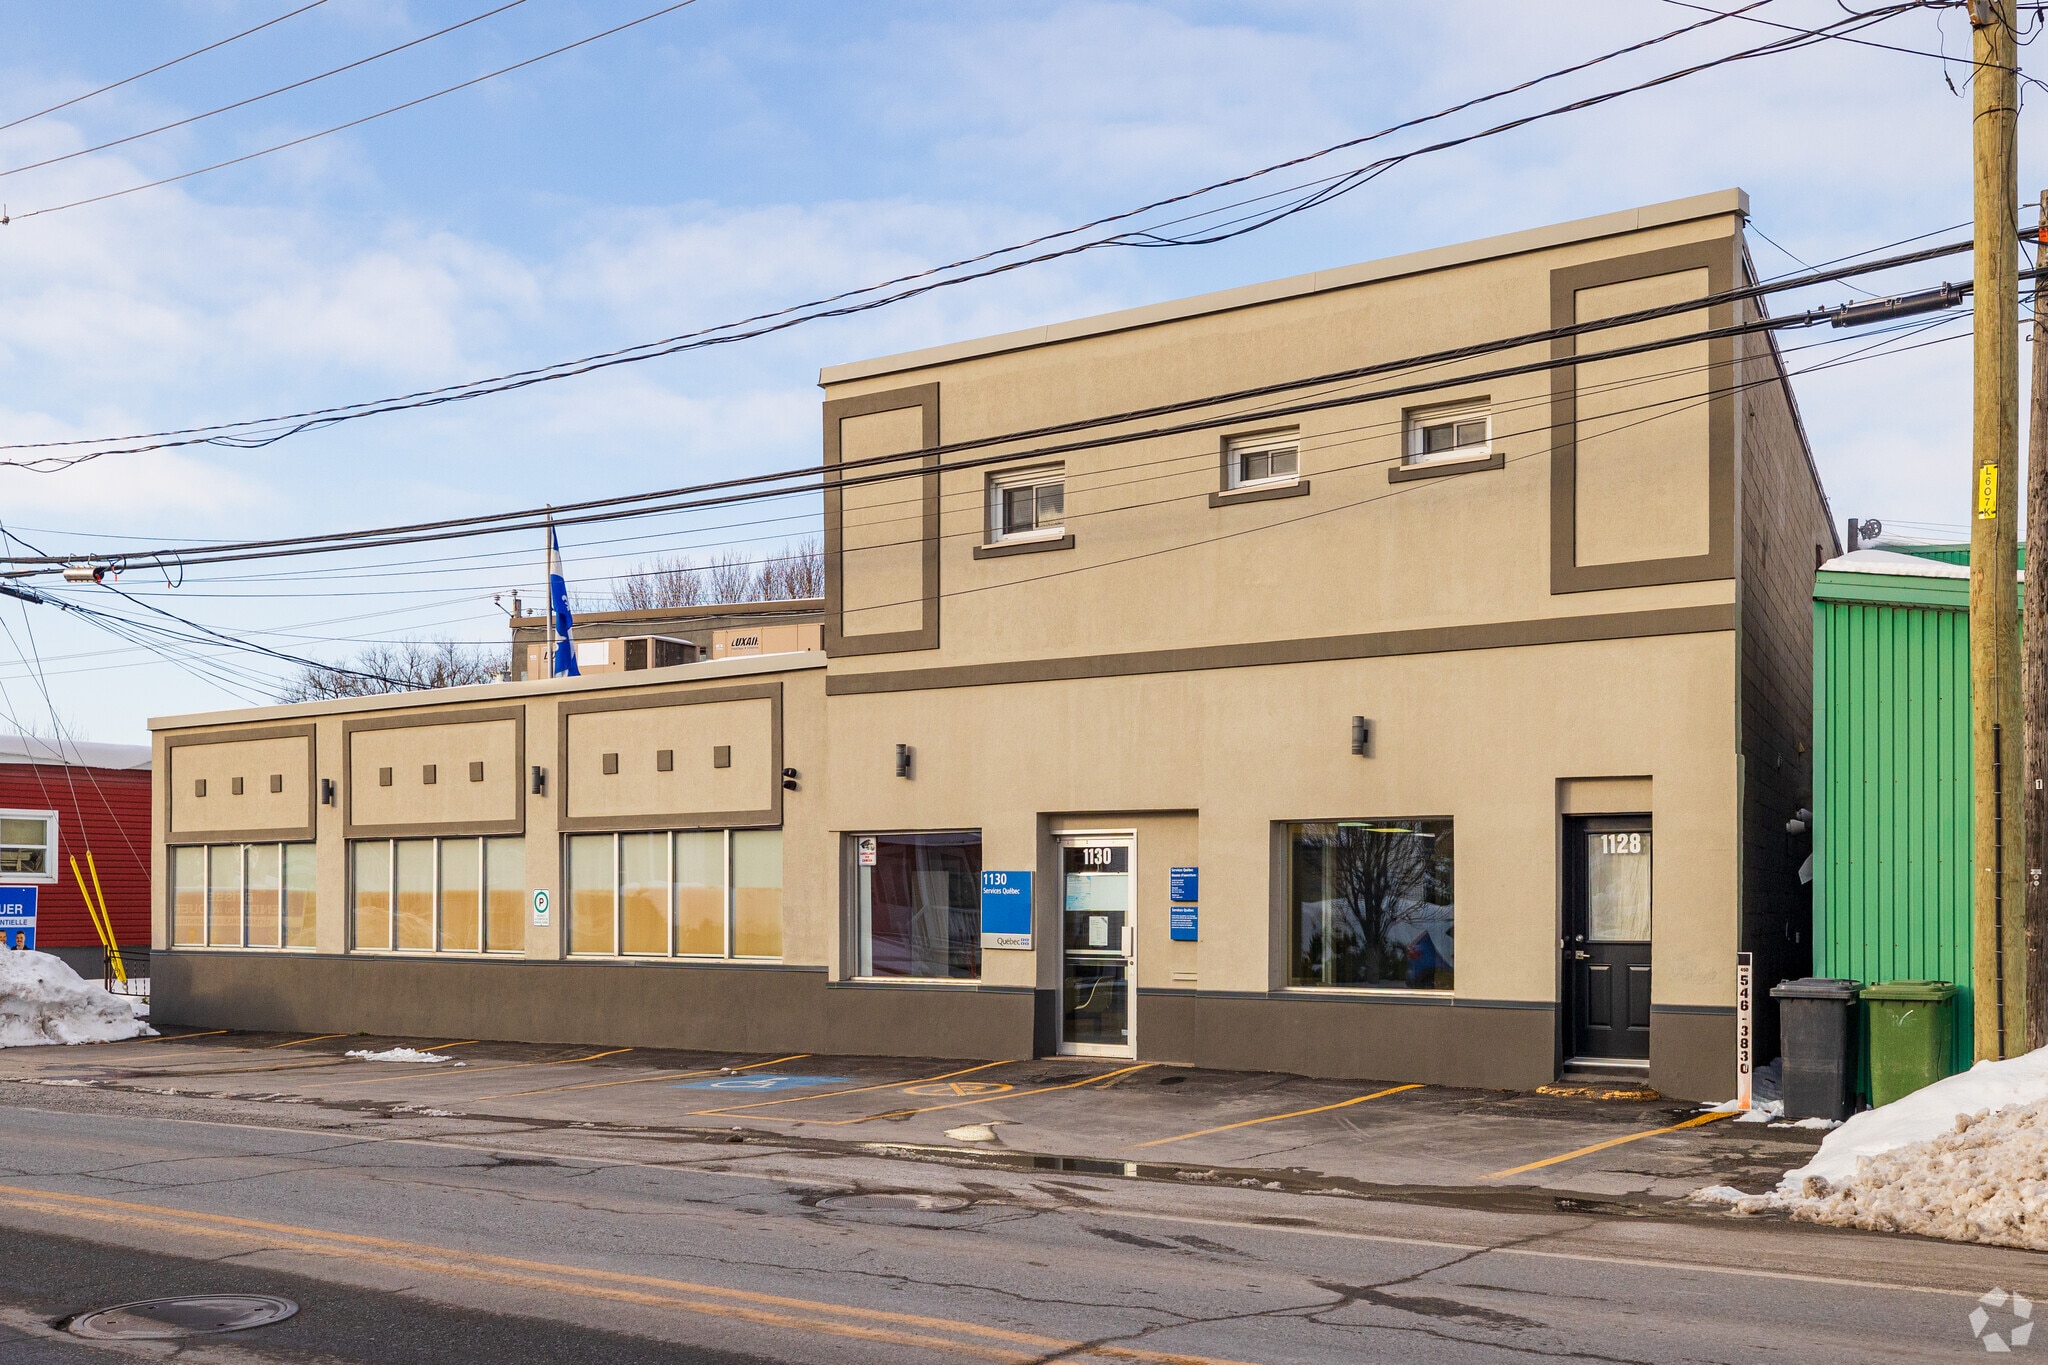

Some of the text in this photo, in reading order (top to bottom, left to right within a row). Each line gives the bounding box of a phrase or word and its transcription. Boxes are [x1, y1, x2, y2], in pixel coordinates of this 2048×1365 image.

[1600, 833, 1641, 854] 1128
[1083, 847, 1112, 865] 1130
[983, 873, 1008, 885] 1130
[983, 887, 1021, 895] Services Québec
[538, 897, 544, 907] P
[997, 937, 1020, 946] Québec
